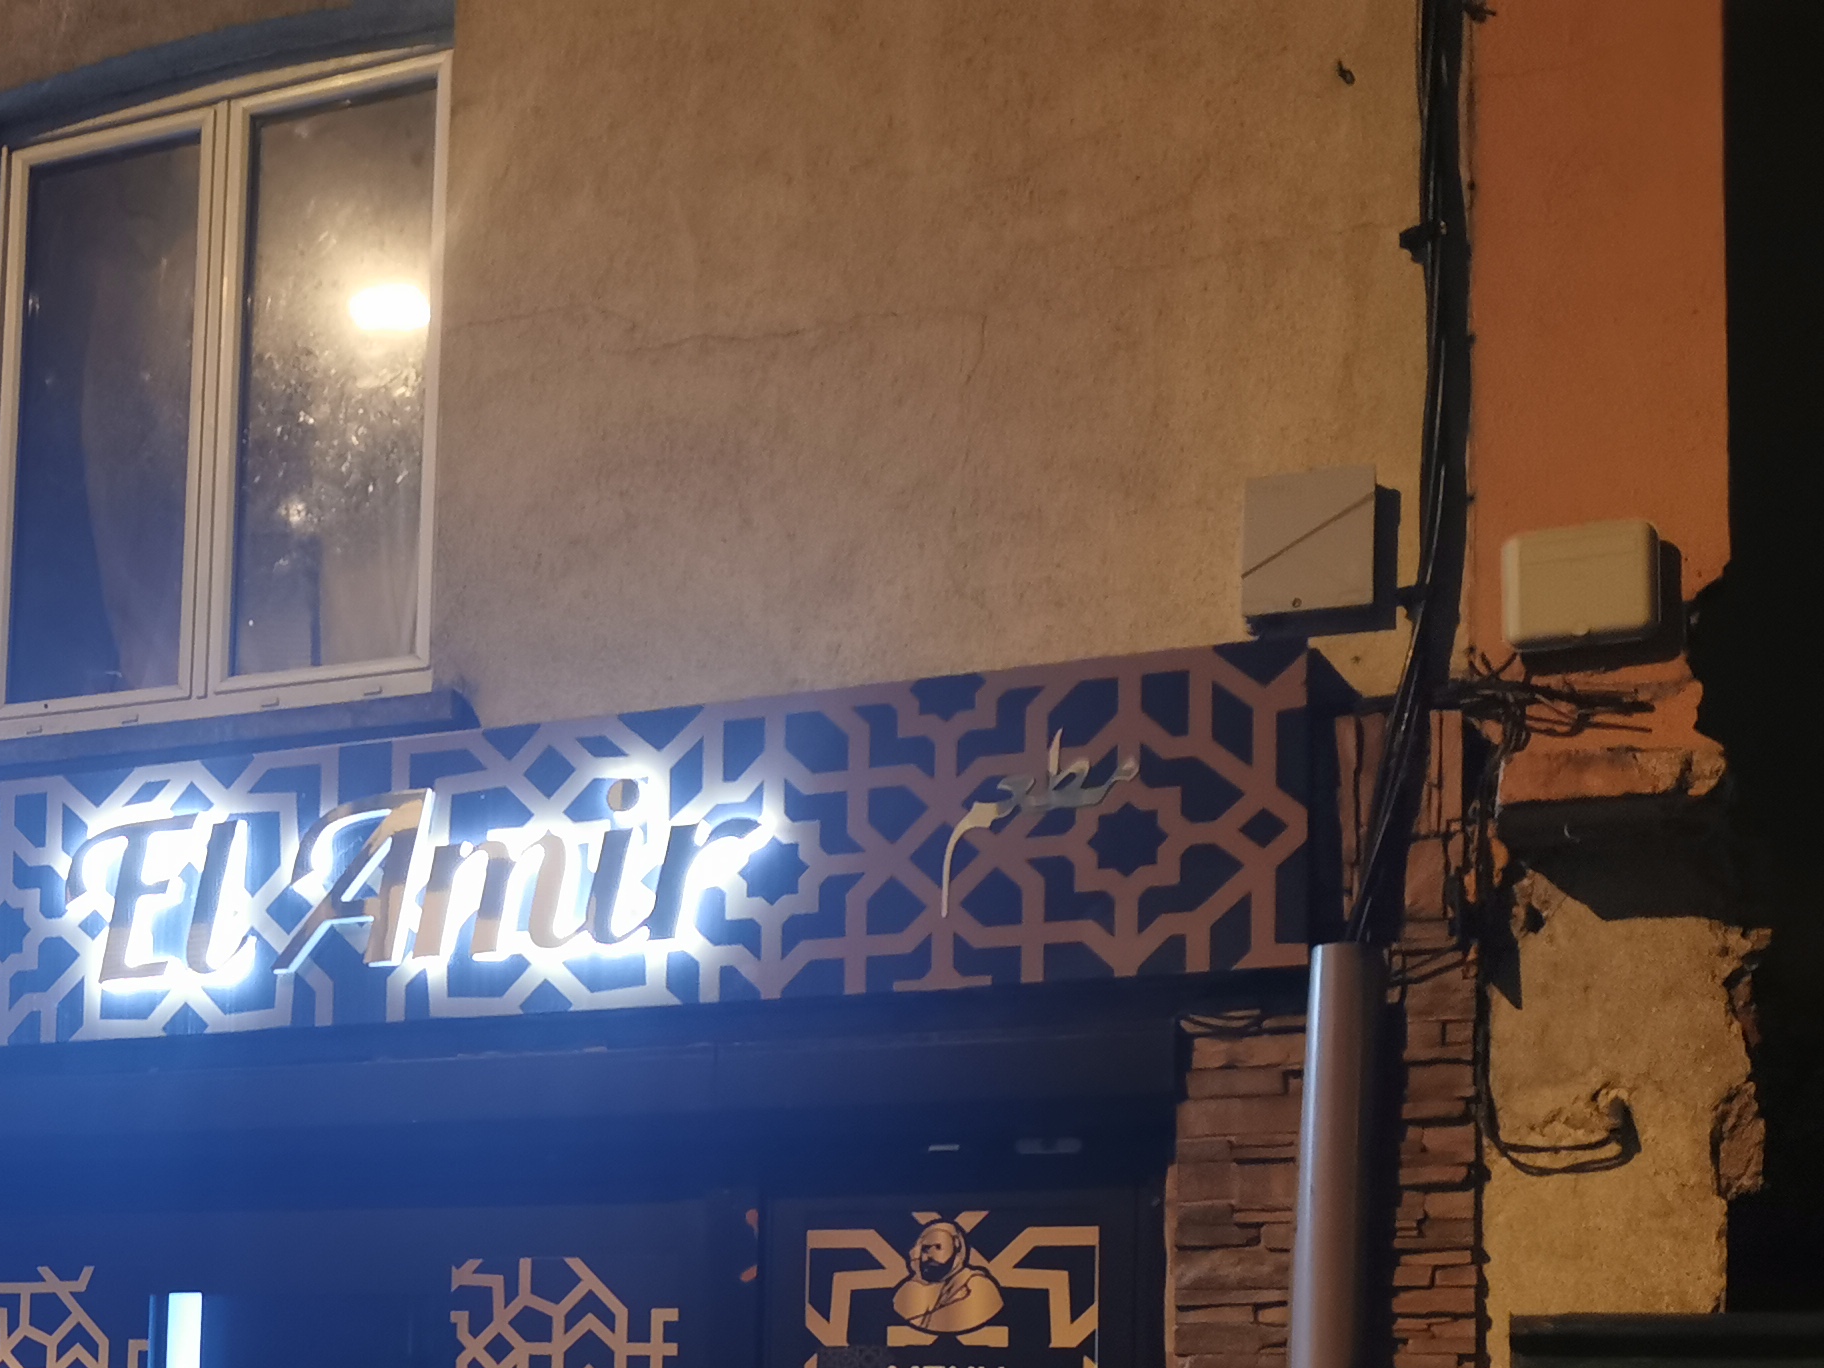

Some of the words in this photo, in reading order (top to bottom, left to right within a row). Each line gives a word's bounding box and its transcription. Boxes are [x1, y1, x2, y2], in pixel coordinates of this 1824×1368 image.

[66, 811, 255, 985] El
[274, 775, 773, 975] Amir
[941, 727, 1141, 918] مطعم
